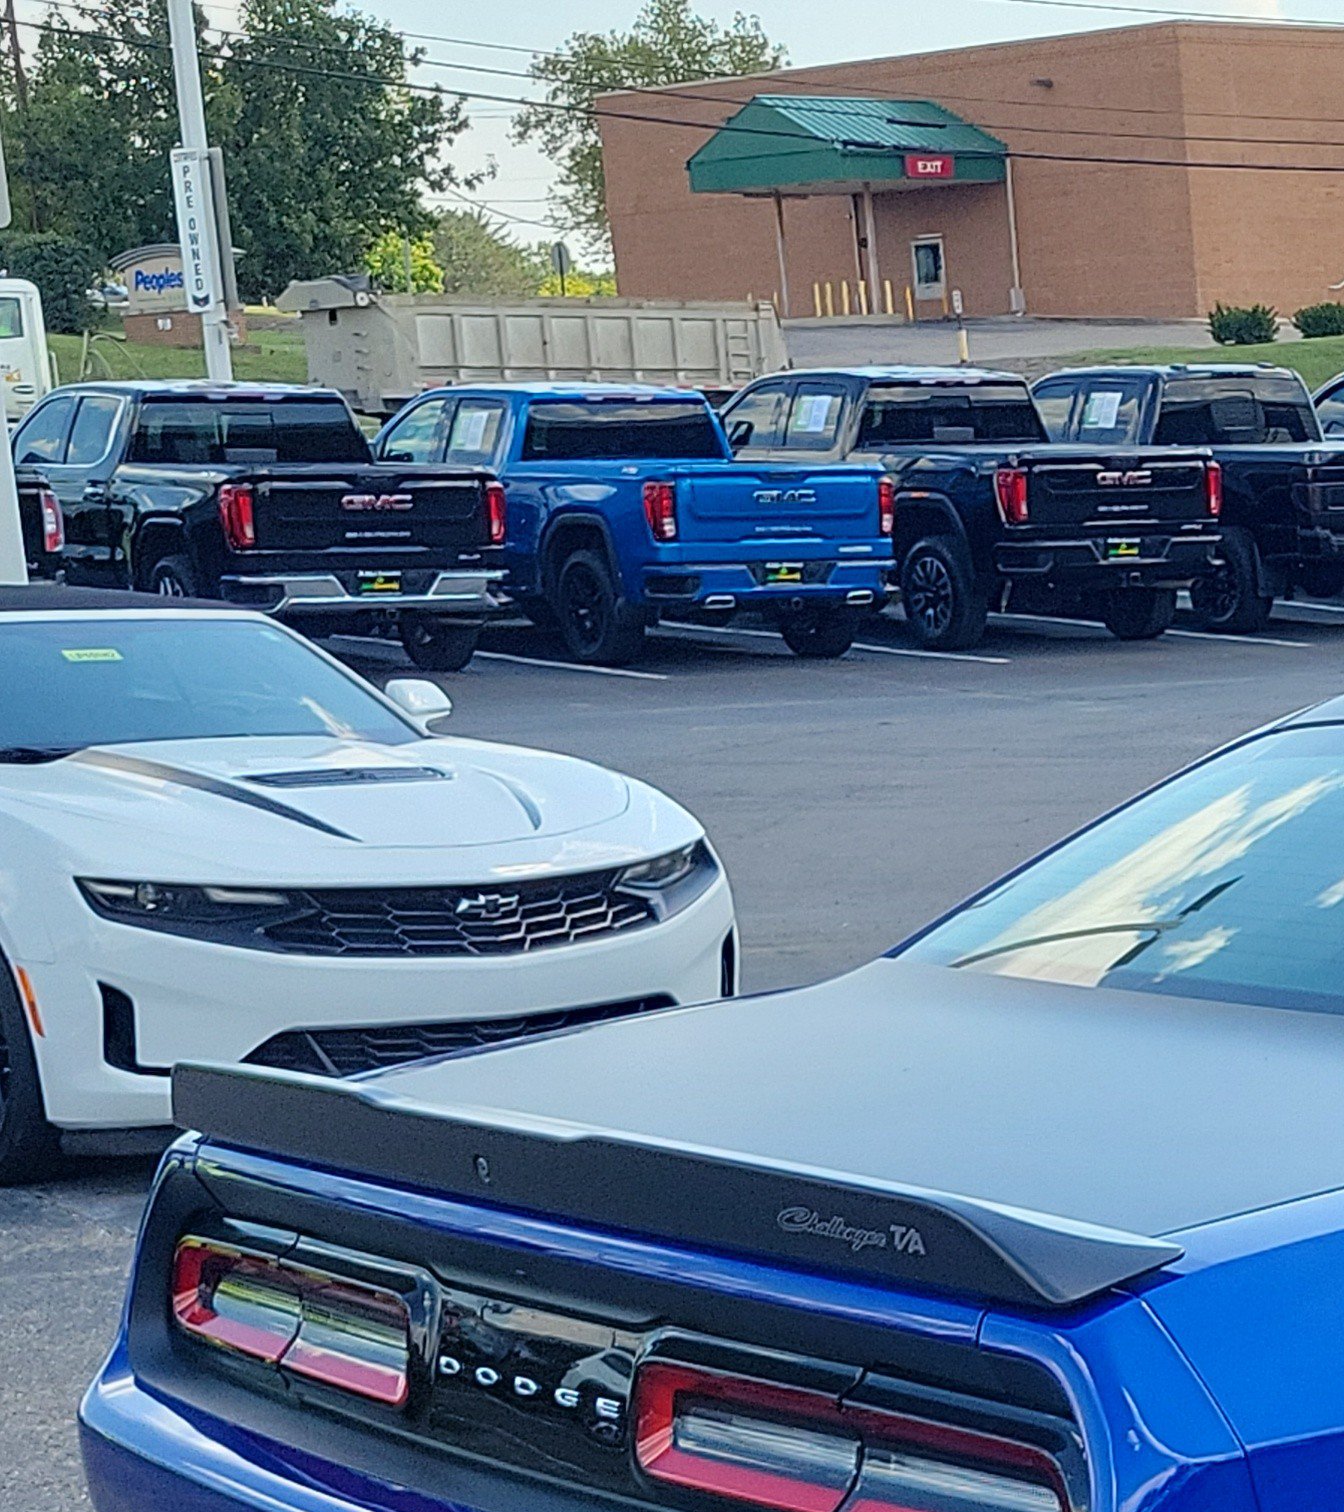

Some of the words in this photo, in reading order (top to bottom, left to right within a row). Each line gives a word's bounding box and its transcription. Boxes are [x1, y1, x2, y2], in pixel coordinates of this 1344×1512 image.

[917, 160, 943, 174] EXIT
[134, 266, 184, 294] Peoples
[777, 1206, 887, 1251] Challenger
[439, 1355, 621, 1420] DODGE
